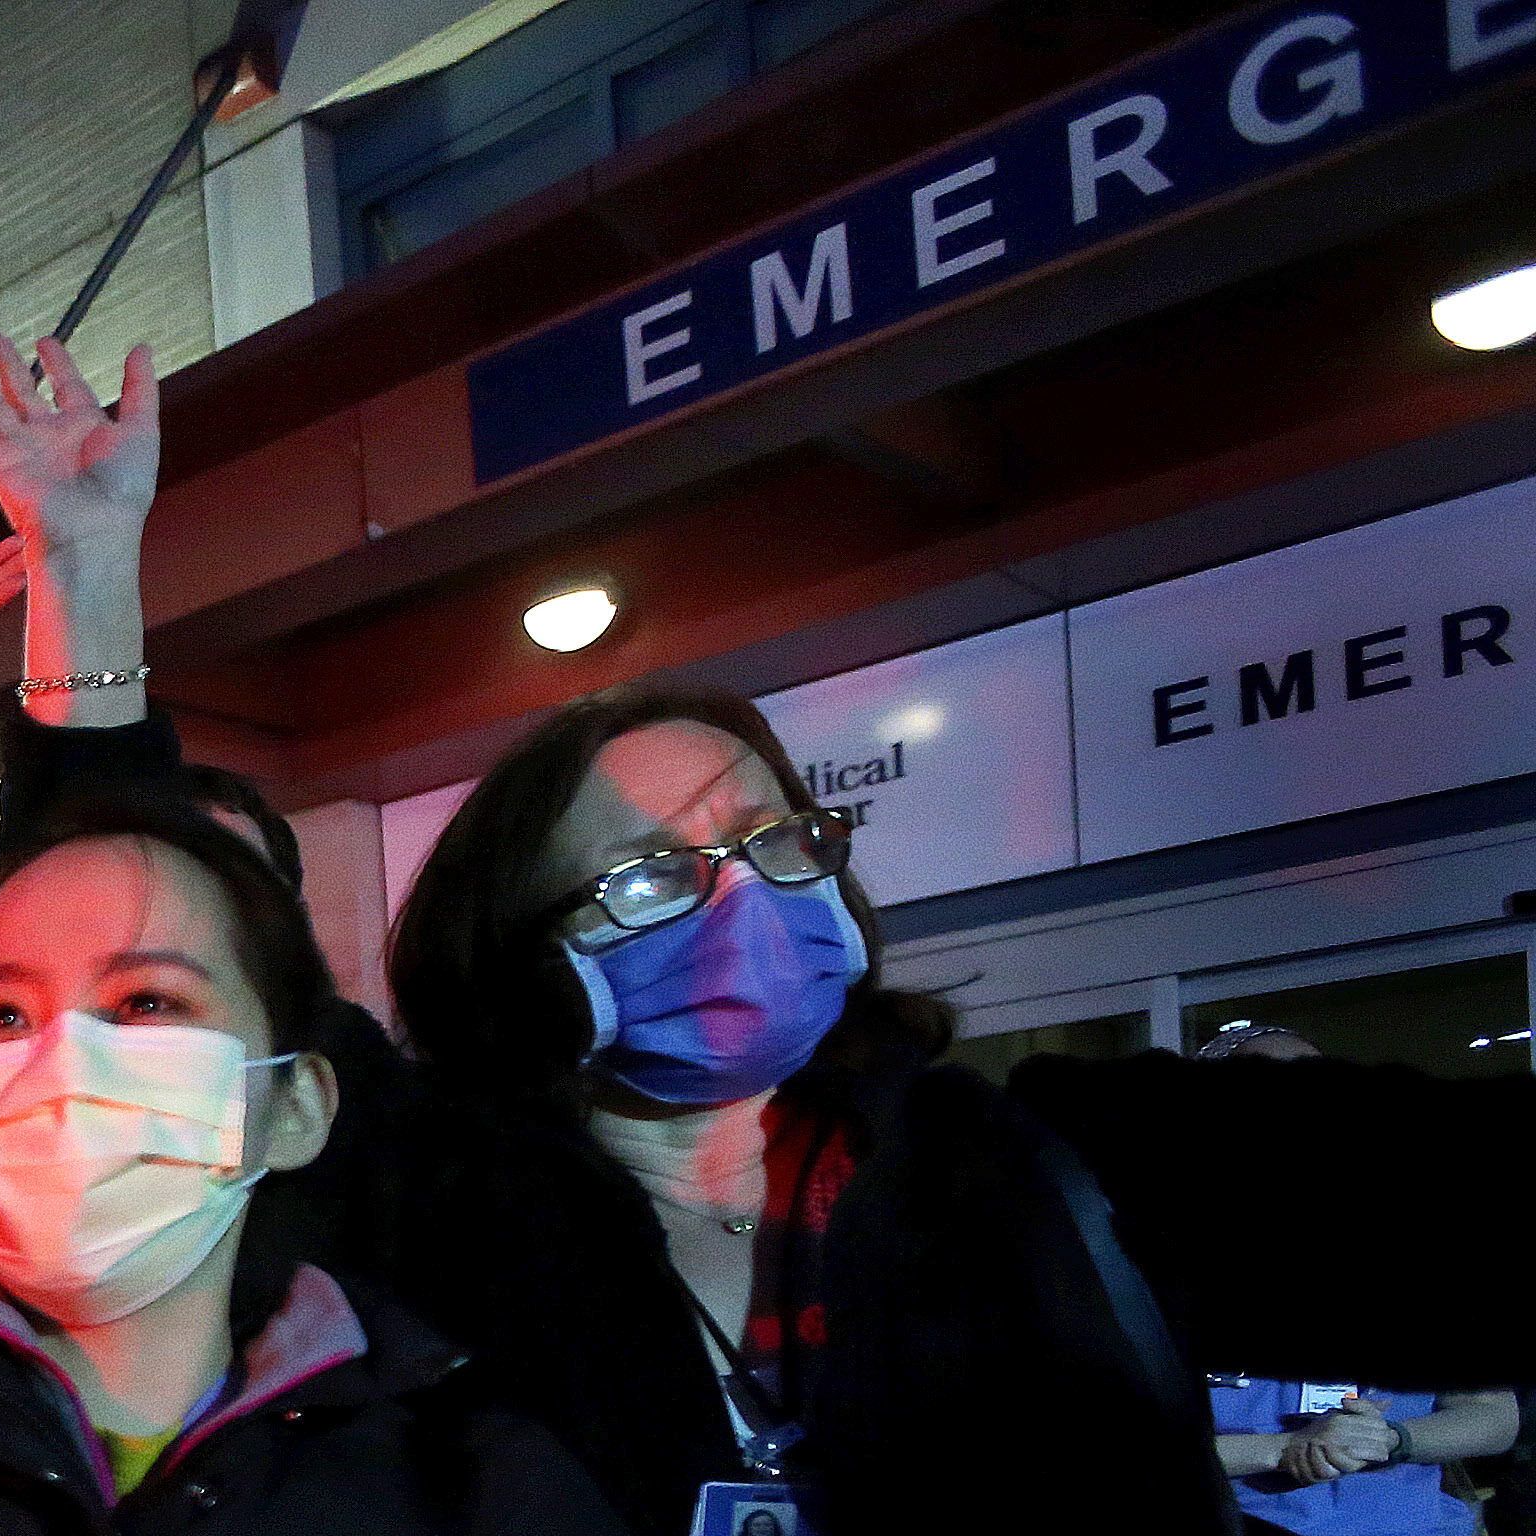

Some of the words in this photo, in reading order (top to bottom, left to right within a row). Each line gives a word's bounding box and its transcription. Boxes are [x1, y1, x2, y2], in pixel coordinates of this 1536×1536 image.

[621, 0, 1536, 407] EMERGE
[1152, 604, 1514, 748] EMER
[804, 740, 906, 798] dical
